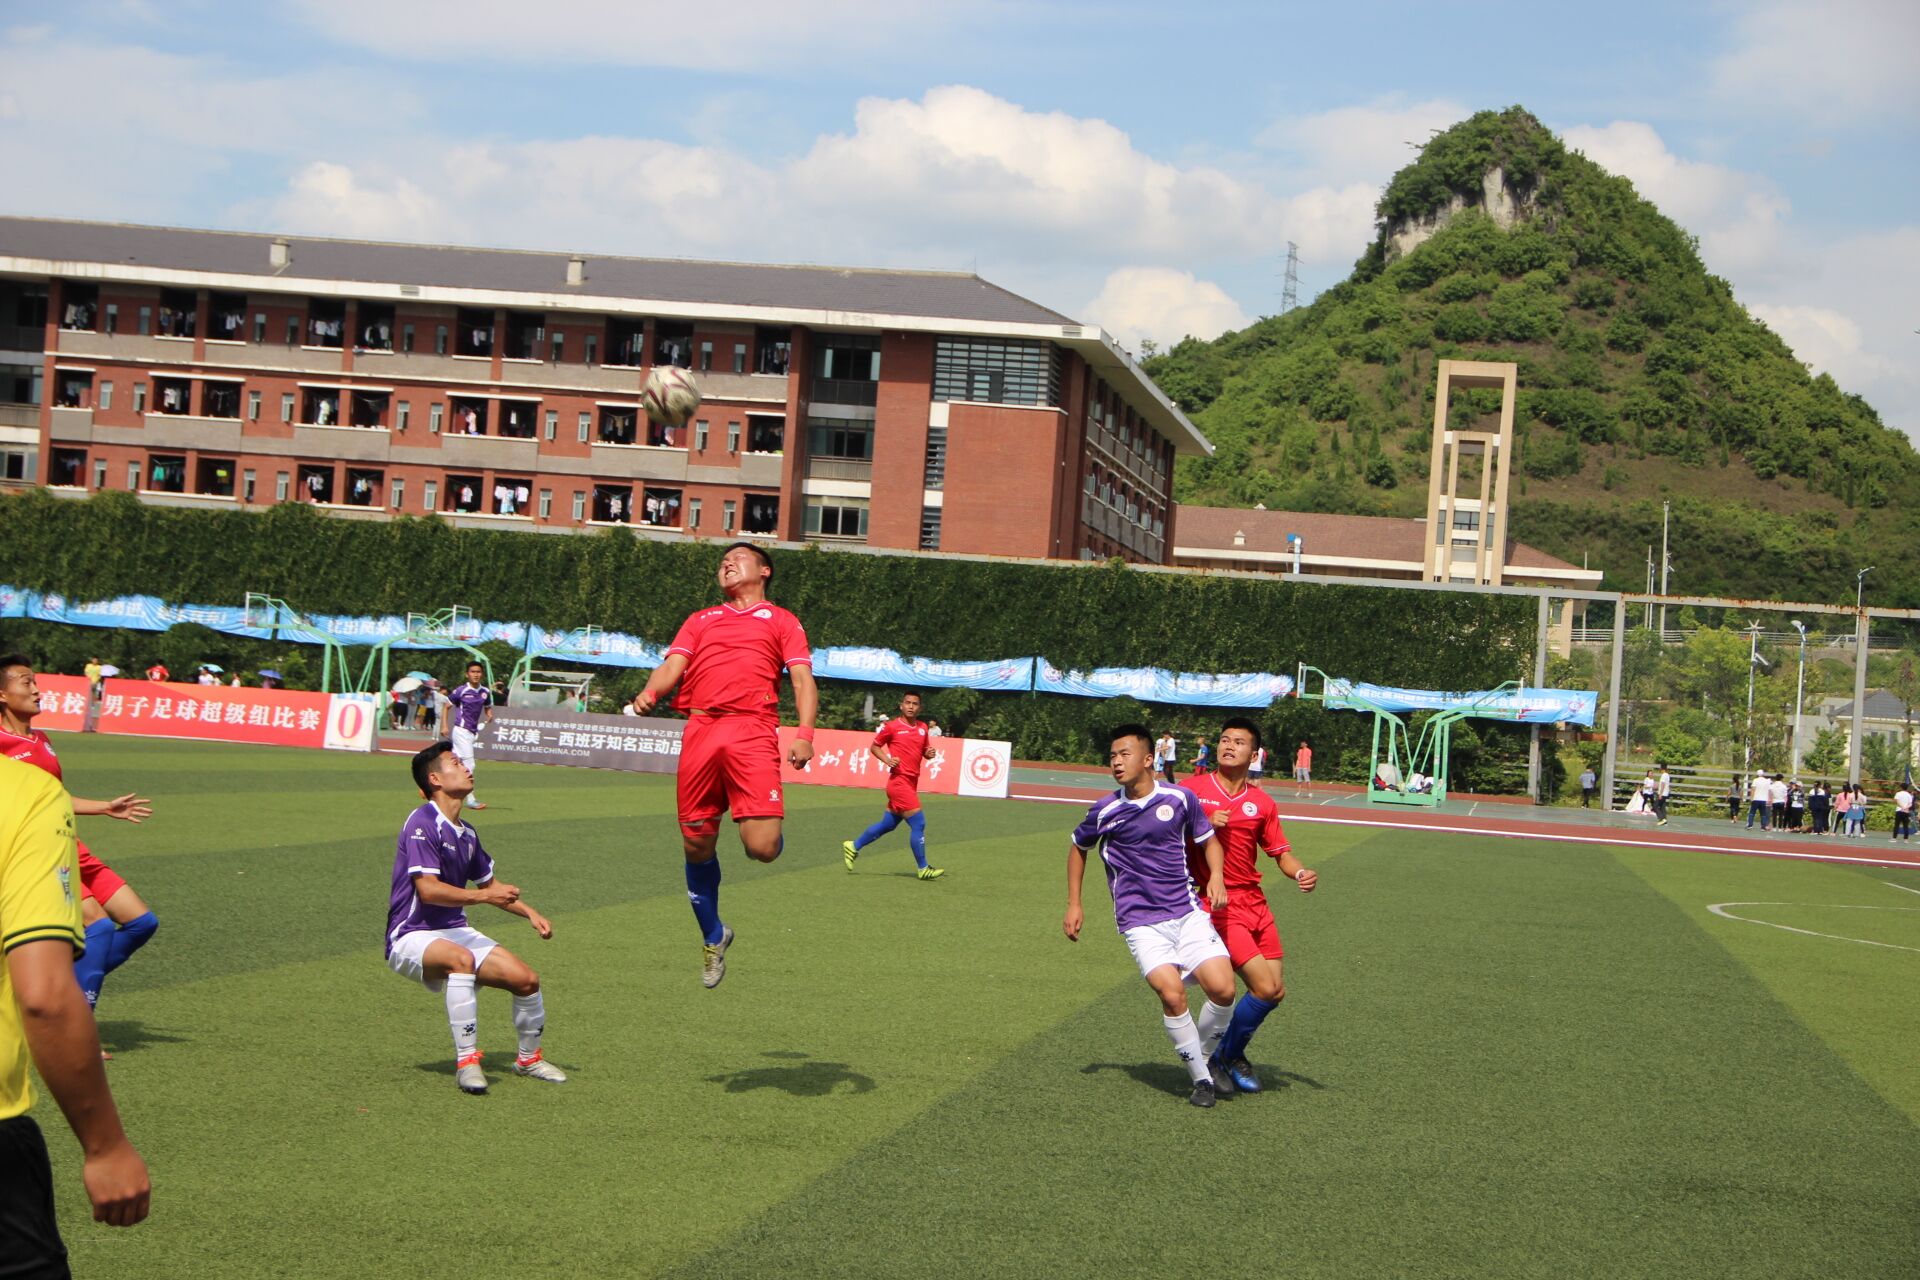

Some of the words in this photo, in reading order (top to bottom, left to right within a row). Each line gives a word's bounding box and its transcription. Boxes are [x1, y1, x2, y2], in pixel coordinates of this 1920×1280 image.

[40, 691, 86, 715] 高校
[102, 694, 322, 731] 男子足球超级组比赛
[337, 703, 363, 740] 0
[491, 743, 590, 757] WWW.KELMECHINA.COM
